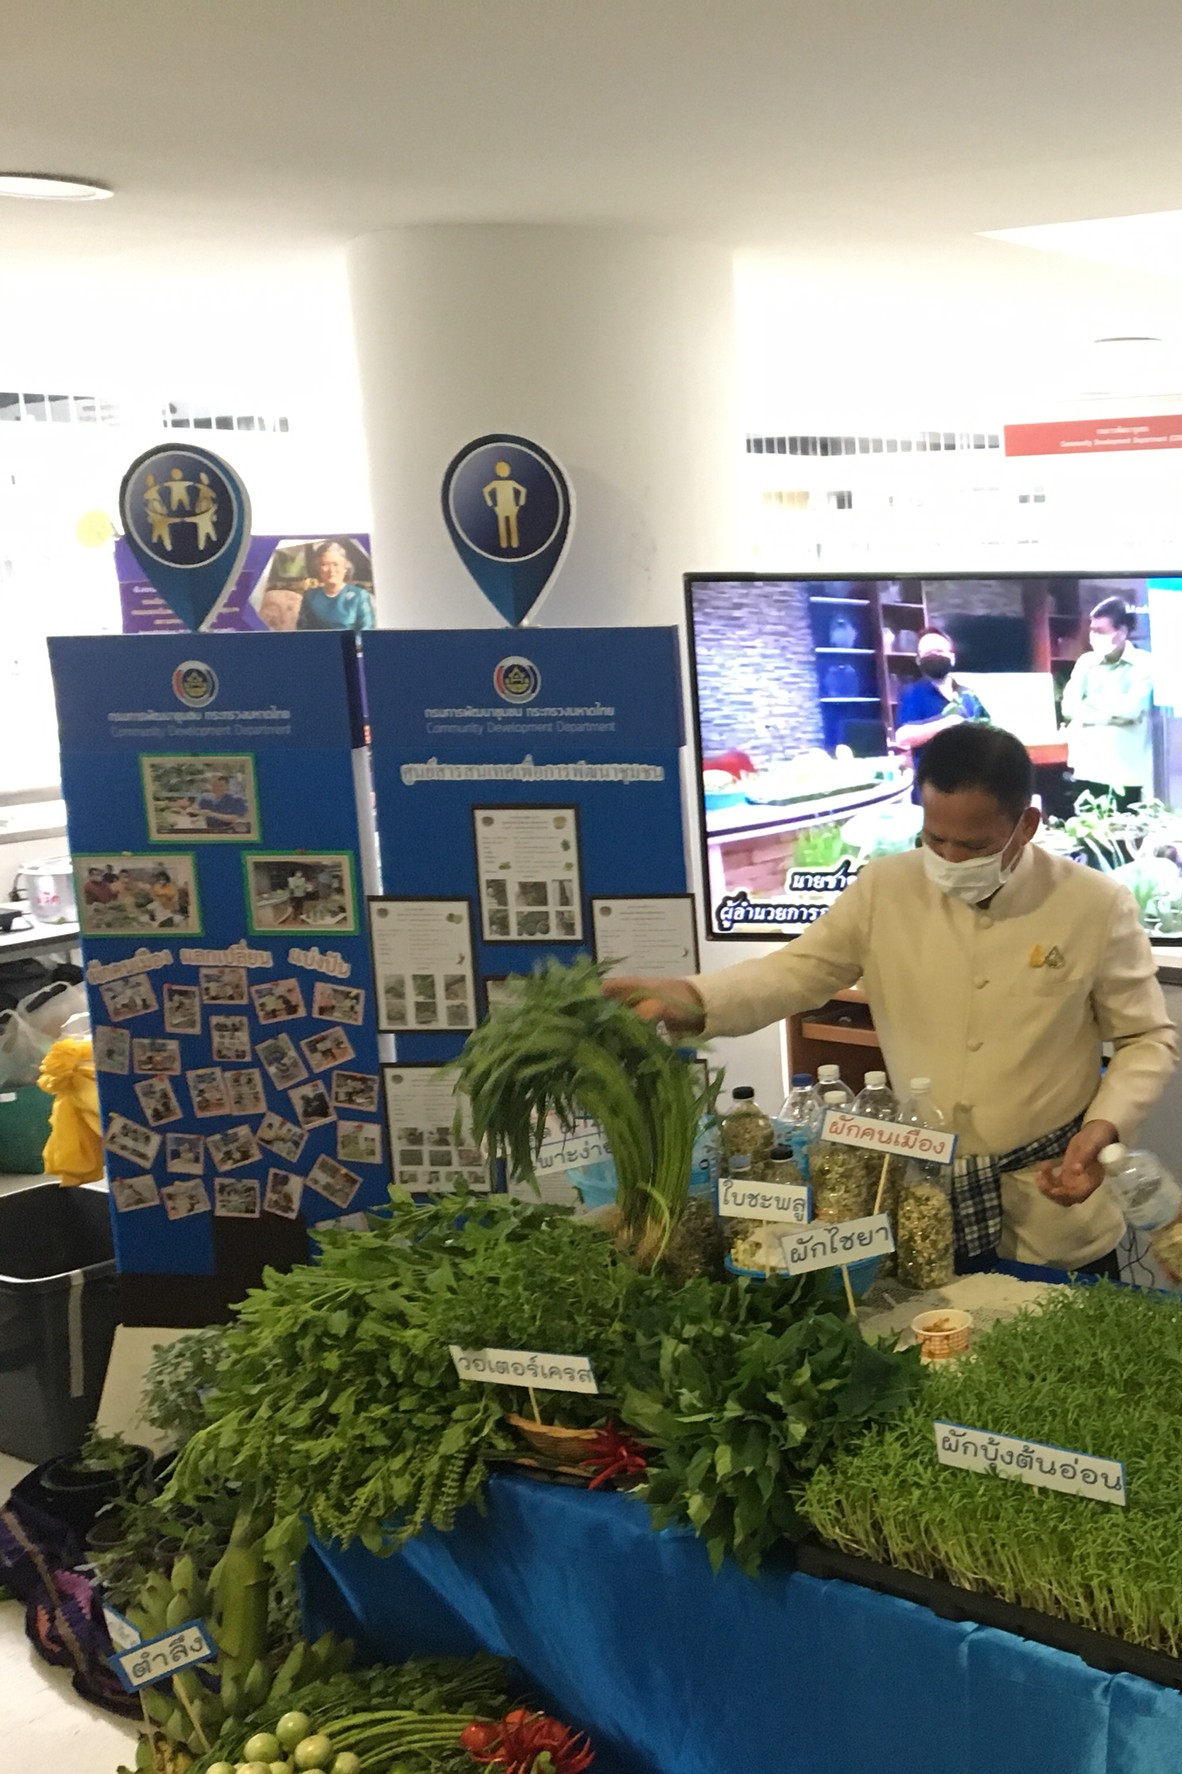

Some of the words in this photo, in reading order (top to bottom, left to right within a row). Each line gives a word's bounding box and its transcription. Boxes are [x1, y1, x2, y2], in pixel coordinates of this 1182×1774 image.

[426, 721, 483, 735] Community
[487, 720, 552, 735] Development
[556, 720, 616, 734] Department
[828, 1114, 946, 1154] ผักคนเมือง
[722, 1179, 806, 1222] ใบชะพลู
[790, 1226, 889, 1264] ผักไชยา
[458, 1355, 593, 1383] วอเตอร์เครส
[941, 1428, 1123, 1491] ผักบุ้งต้นอ่อน
[132, 1634, 203, 1678] ตำลึง
